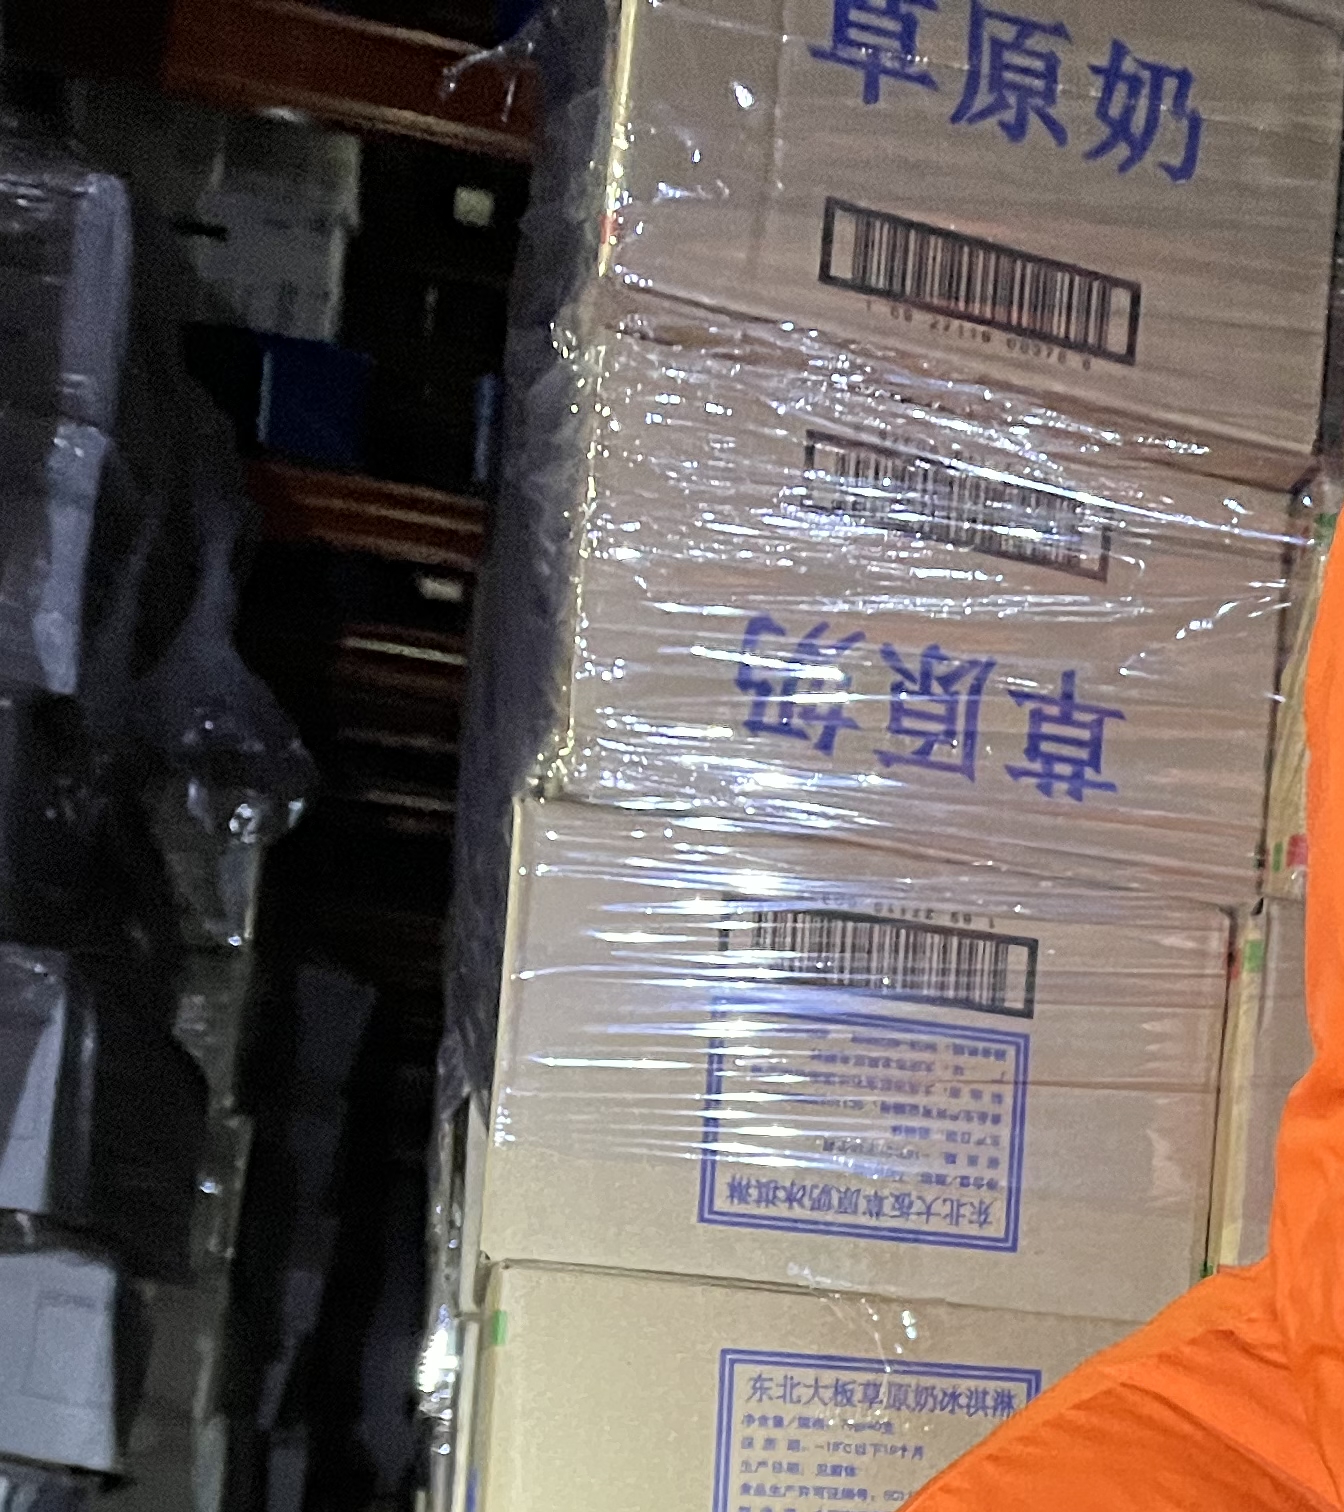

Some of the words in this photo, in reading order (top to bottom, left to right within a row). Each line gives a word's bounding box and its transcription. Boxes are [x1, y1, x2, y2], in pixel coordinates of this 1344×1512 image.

[809, 0, 1202, 184] 草原奶
[735, 614, 1126, 801] 草原奶
[725, 1175, 994, 1229] 东北大板草原奶冰淇淋
[747, 1373, 1016, 1419] 东北大板草原奶冰淇淋
